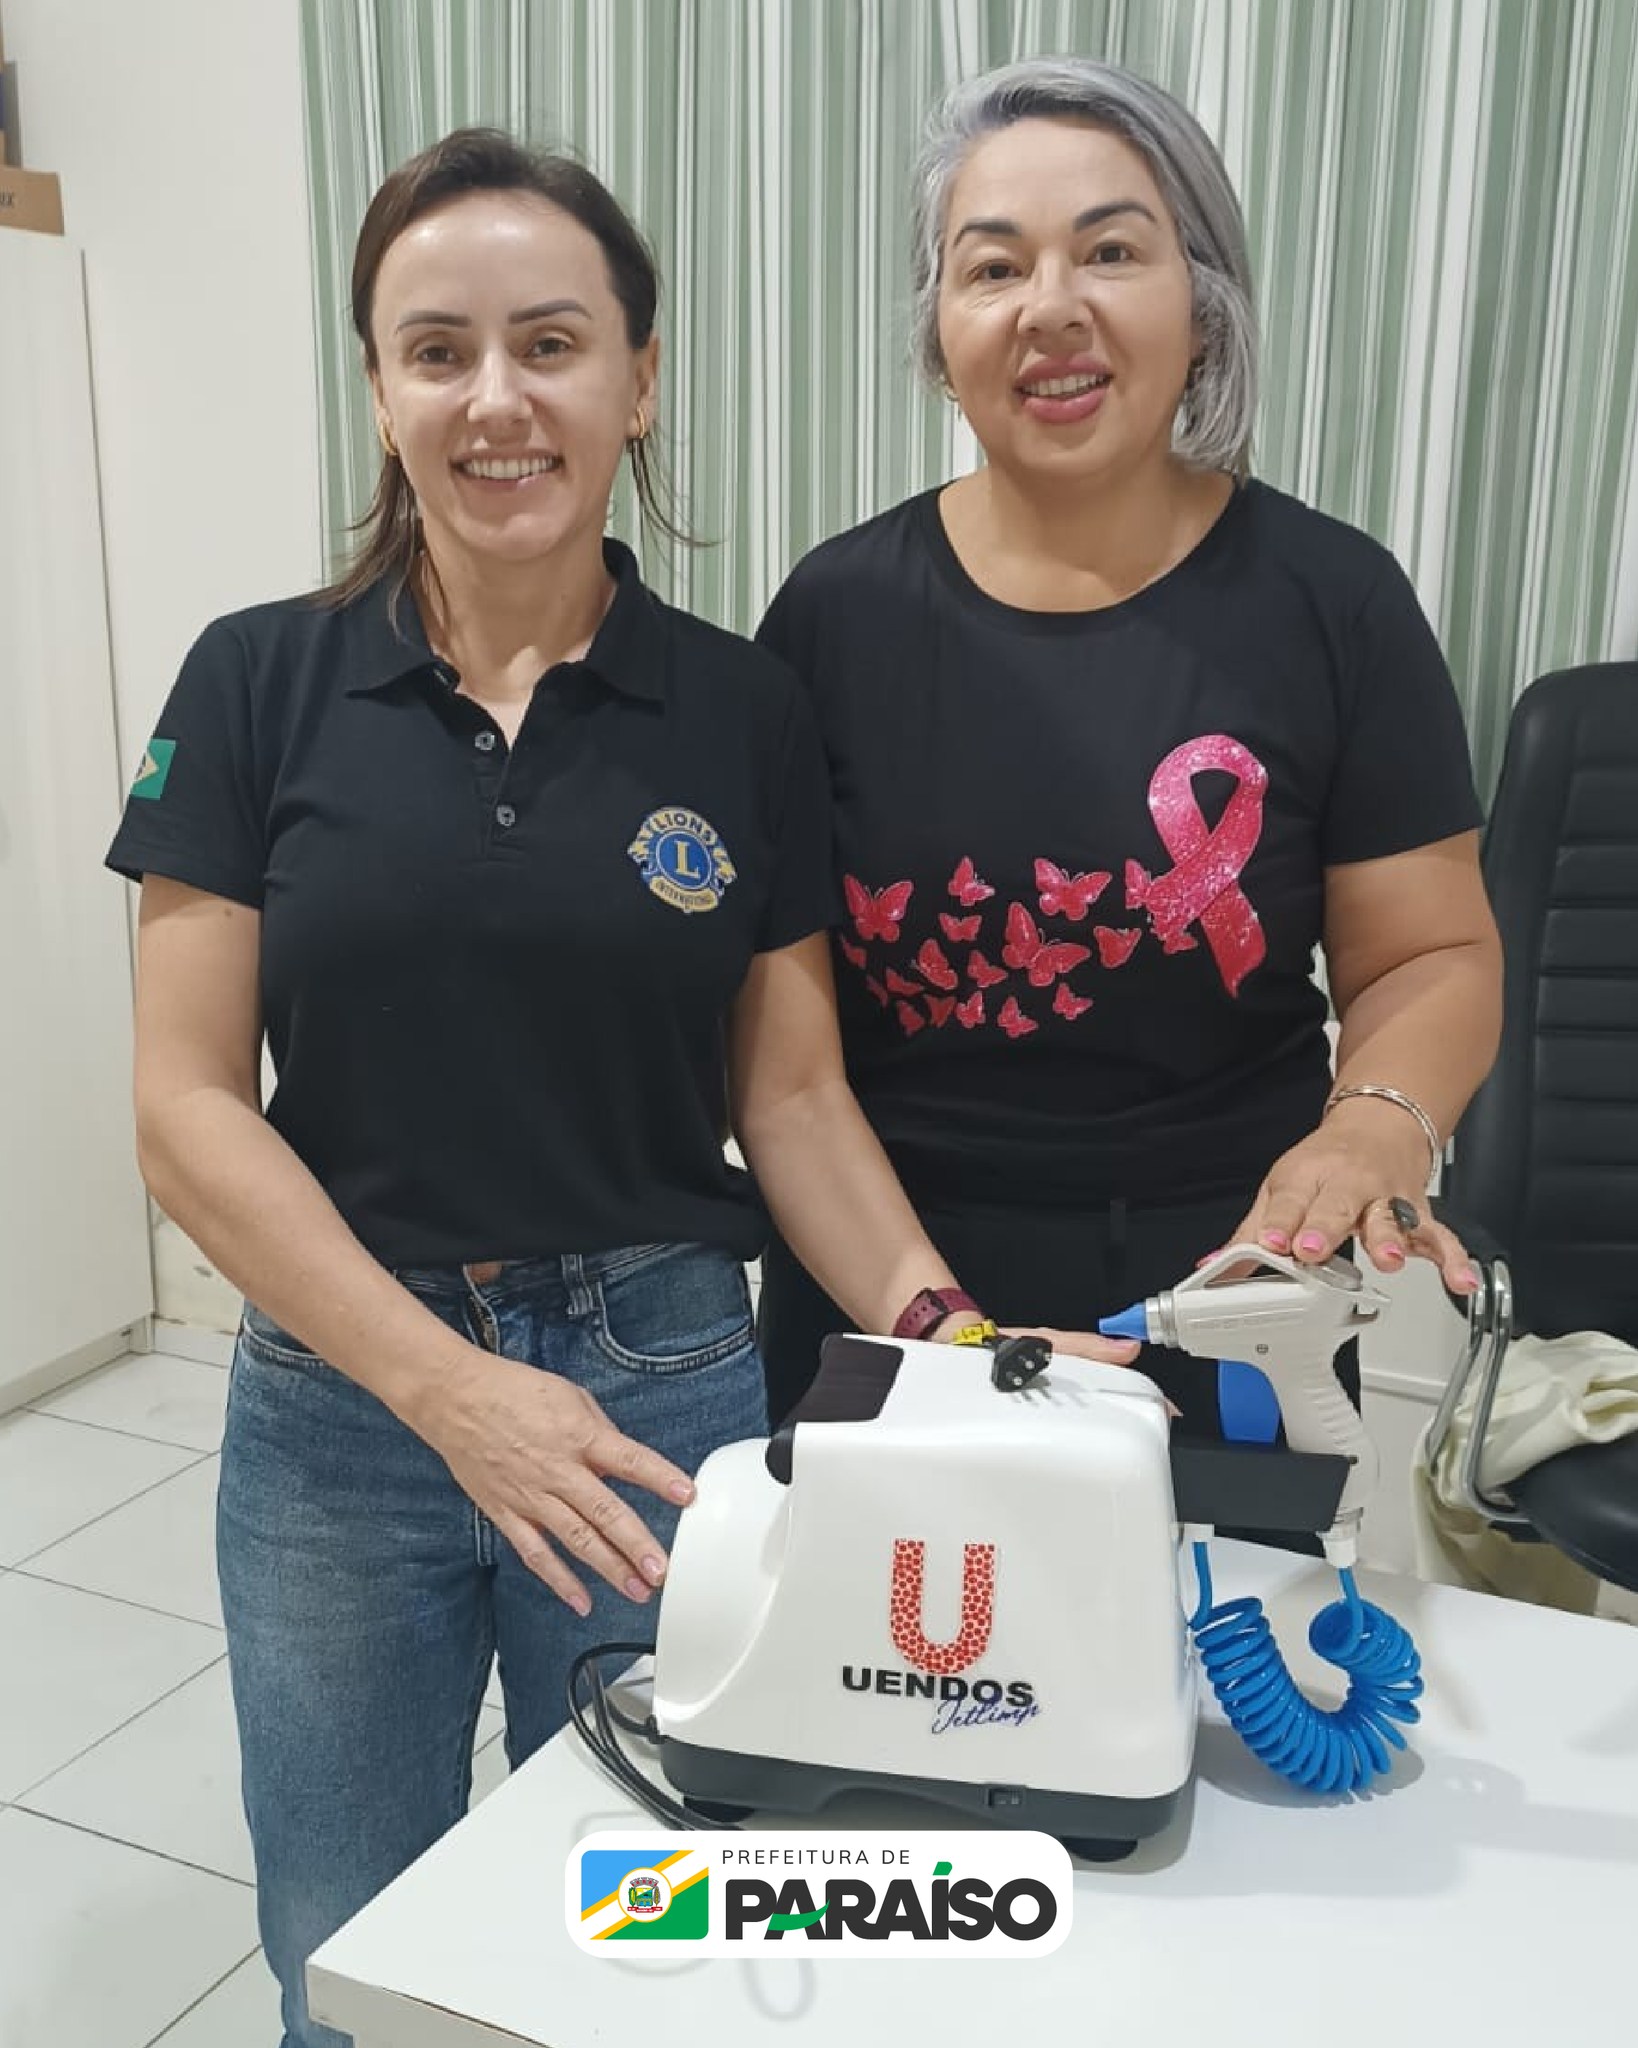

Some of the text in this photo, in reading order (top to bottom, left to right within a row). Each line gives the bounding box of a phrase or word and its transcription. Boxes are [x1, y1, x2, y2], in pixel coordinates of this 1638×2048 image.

[653, 811, 715, 845] LIONS
[674, 839, 701, 879] L
[890, 1538, 995, 1675] U
[842, 1665, 1035, 1708] UENDOS
